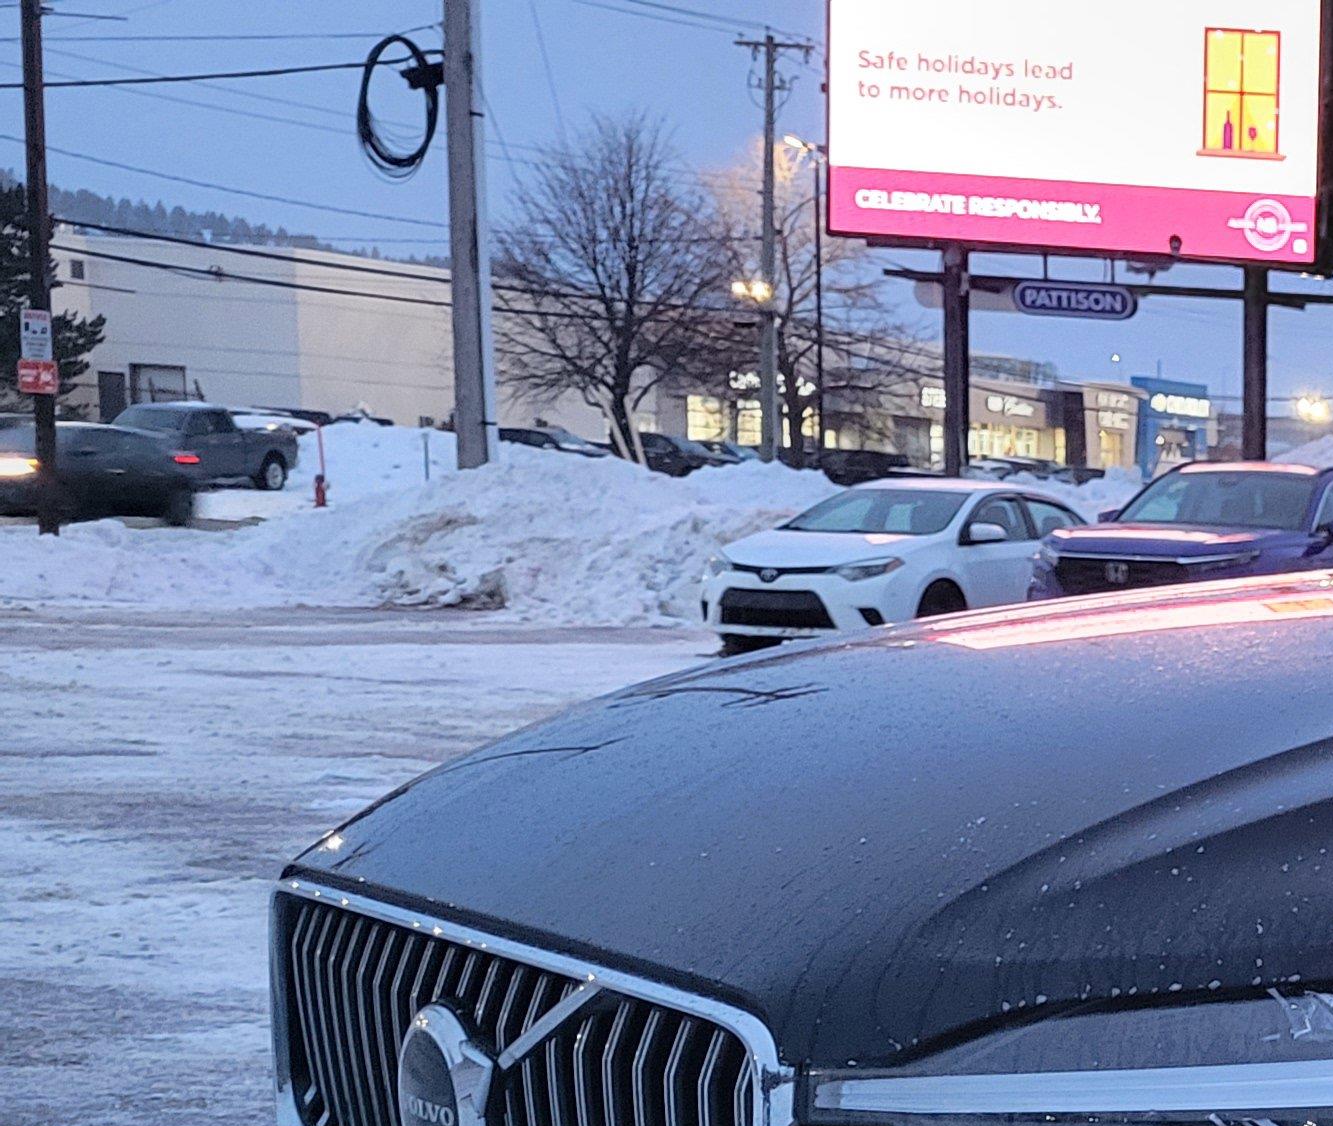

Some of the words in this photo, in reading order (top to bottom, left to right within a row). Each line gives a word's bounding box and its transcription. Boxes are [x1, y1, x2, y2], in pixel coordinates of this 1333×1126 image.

[858, 49, 908, 70] Safe
[917, 53, 1015, 80] holidays
[1024, 59, 1073, 80] lead
[858, 80, 880, 98] to
[889, 85, 949, 102] more
[958, 85, 1063, 112] holidays.
[855, 189, 967, 214] CELEBRATE
[968, 196, 1102, 224] RESPONSIBLY.
[1024, 288, 1122, 312] PATTISON
[405, 1095, 455, 1126] OLVO
